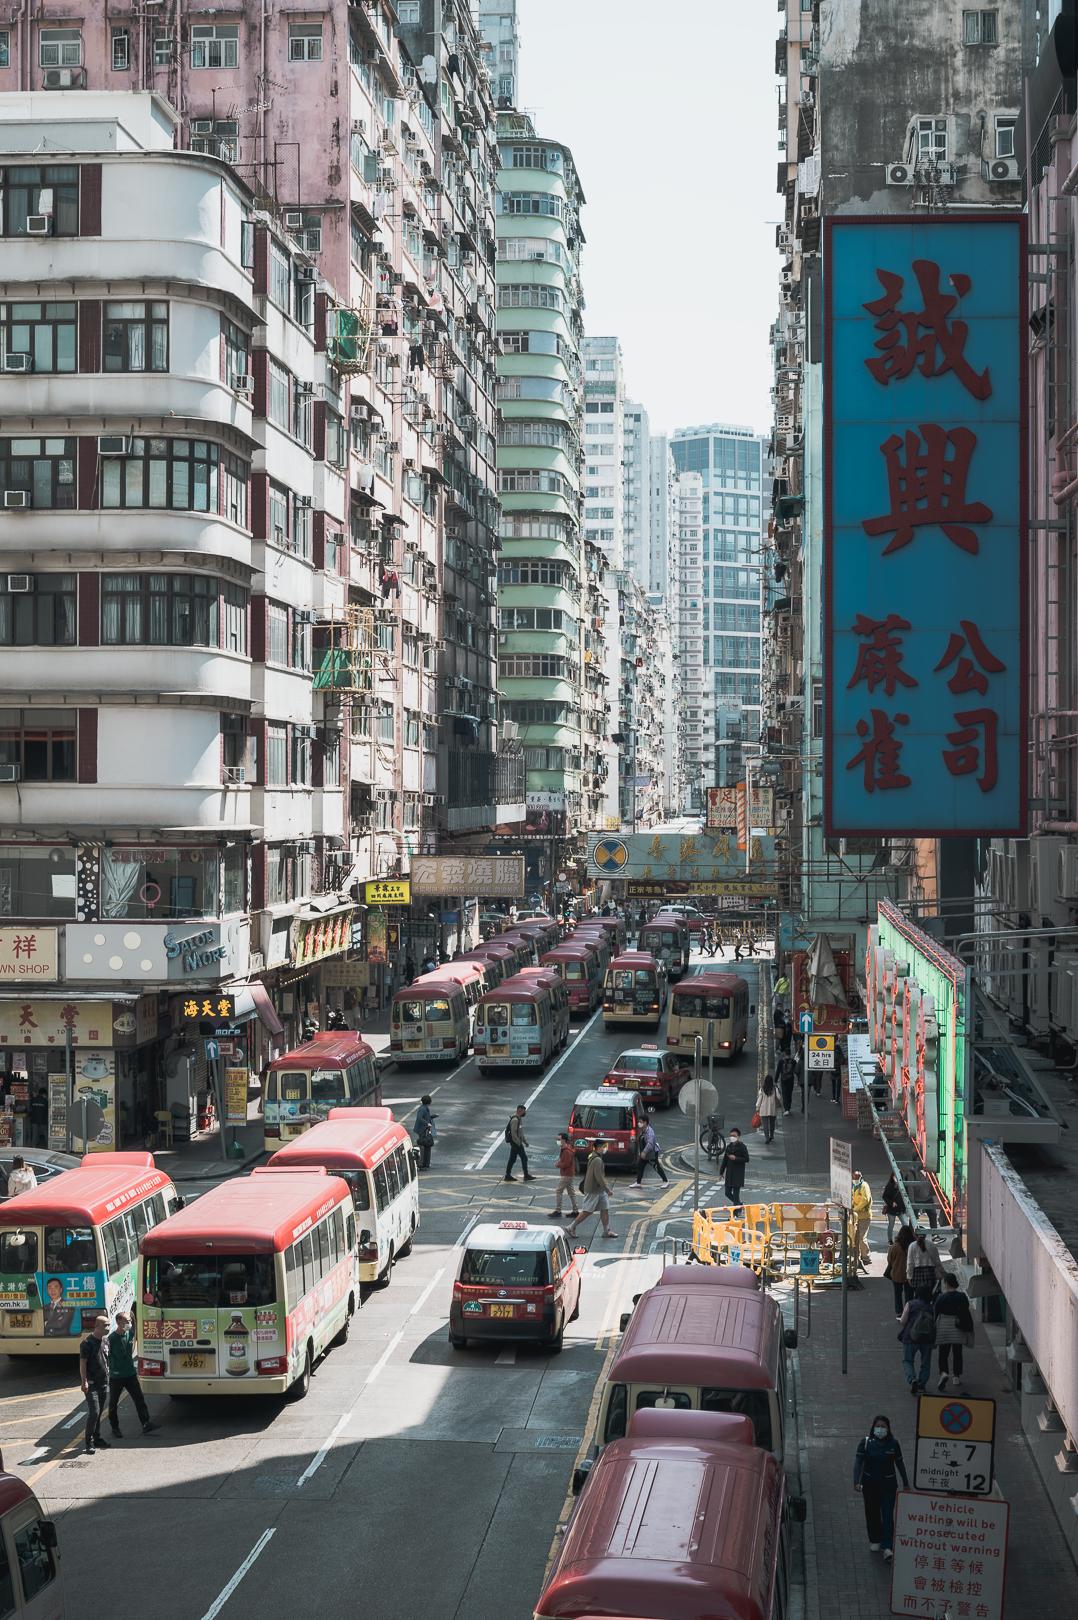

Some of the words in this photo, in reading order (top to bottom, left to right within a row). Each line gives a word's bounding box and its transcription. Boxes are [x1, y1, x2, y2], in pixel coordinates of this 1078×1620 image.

[862, 259, 994, 556] 誠興
[933, 619, 1007, 794] 公司
[18, 964, 50, 974] SHOP
[19, 1003, 80, 1028] 天堂
[184, 999, 232, 1018] 海天堂
[214, 1028, 241, 1036] more
[813, 1059, 830, 1067] 全日
[929, 1450, 951, 1460] 上午
[965, 1444, 977, 1461] 7
[920, 1467, 959, 1477] midnight
[964, 1473, 986, 1491] 12
[928, 1477, 950, 1488] 午夜
[930, 1501, 975, 1515] Vehicle
[907, 1513, 953, 1527] waiting
[956, 1516, 979, 1528] will
[981, 1518, 996, 1530] be
[916, 1526, 986, 1543] prosecuted
[900, 1536, 948, 1551] without
[951, 1544, 1001, 1558] warning
[913, 1555, 985, 1575] 停車等候
[913, 1575, 983, 1597] 會被檢控
[903, 1594, 992, 1618] 而不予警告
